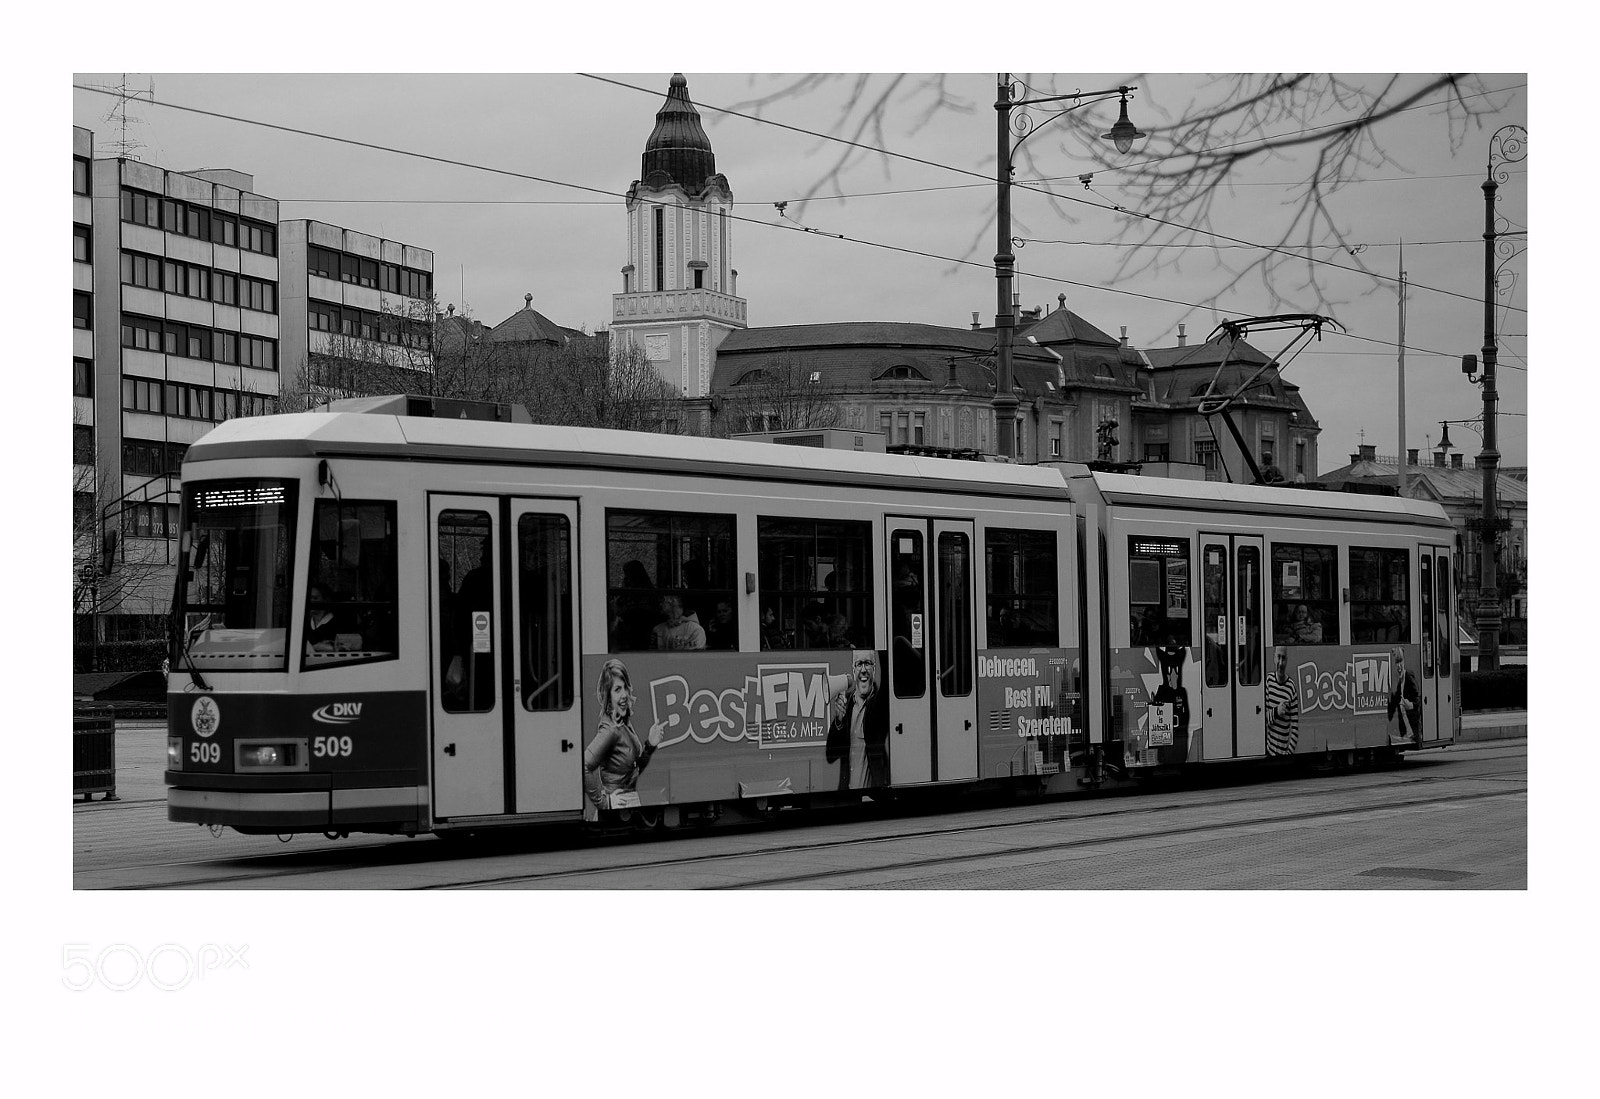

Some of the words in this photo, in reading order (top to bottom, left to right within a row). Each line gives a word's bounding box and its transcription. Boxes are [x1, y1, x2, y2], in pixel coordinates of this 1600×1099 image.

[978, 655, 1039, 678] Debrecen,
[1005, 687, 1032, 709] Best
[1034, 685, 1054, 709] FM,
[1297, 661, 1354, 714] Best
[1355, 659, 1389, 695] FM
[333, 703, 362, 716] DKV
[649, 674, 761, 750] Best
[762, 671, 825, 720] FM
[1357, 696, 1374, 708] 104.6
[1375, 695, 1388, 707] MHz
[800, 720, 825, 738] MHz
[1018, 715, 1082, 738] Szeretem...
[190, 742, 221, 763] 509
[313, 736, 353, 757] 509
